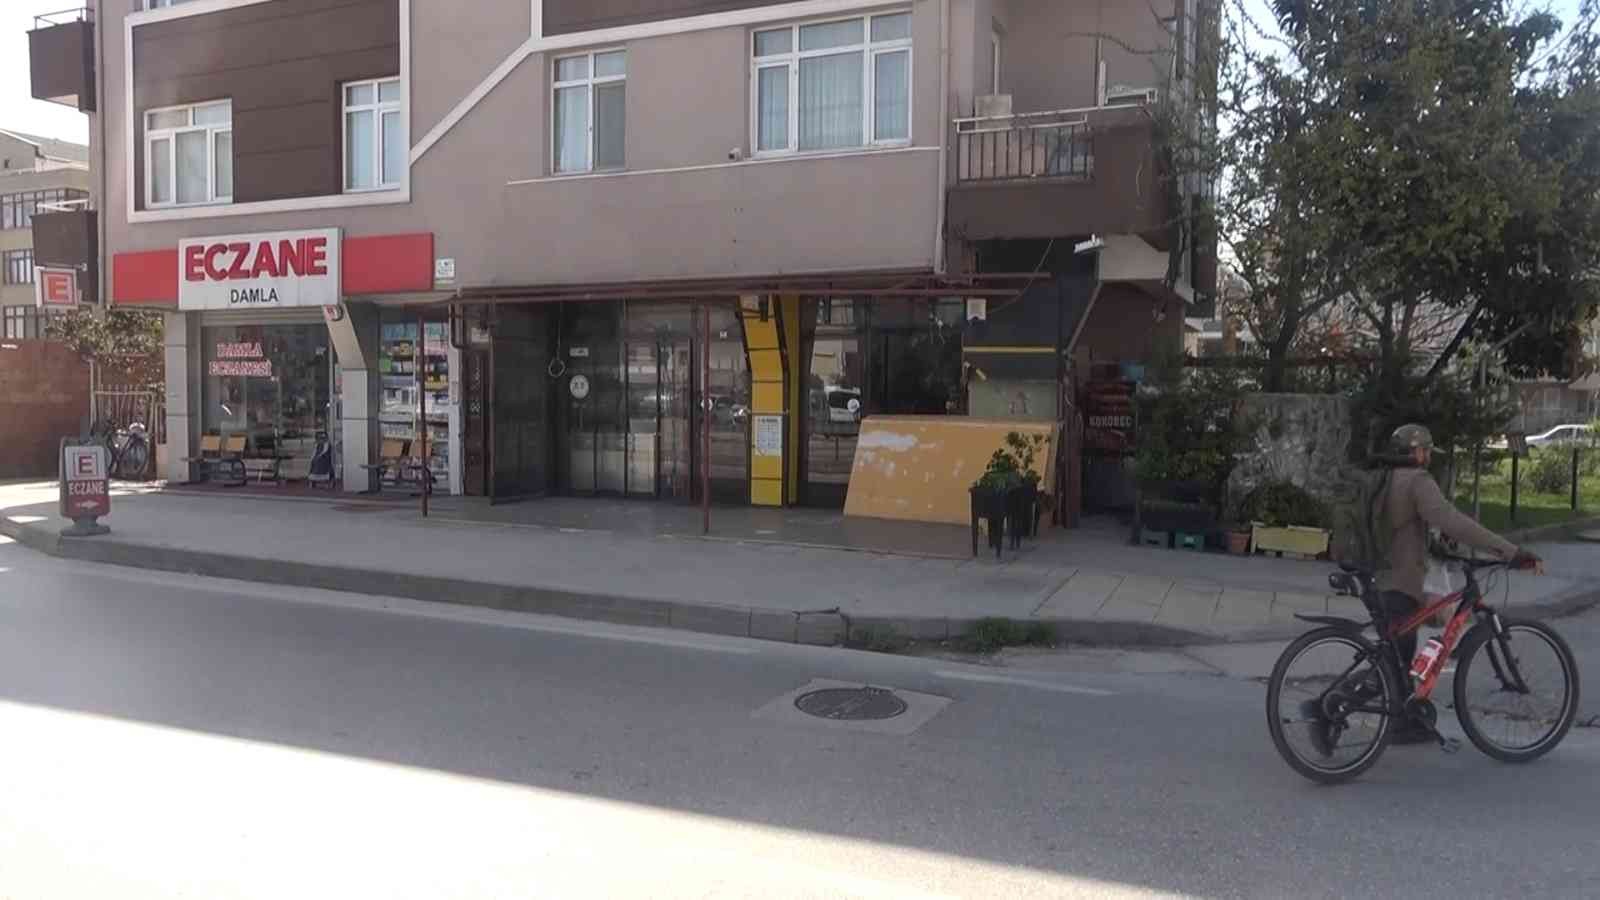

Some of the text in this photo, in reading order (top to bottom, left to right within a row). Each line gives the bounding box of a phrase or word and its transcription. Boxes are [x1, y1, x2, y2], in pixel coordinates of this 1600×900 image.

[185, 237, 327, 281] ECZANE
[230, 288, 278, 303] DAMLA
[216, 342, 264, 357] DAMLA
[79, 455, 94, 474] E
[68, 481, 105, 496] ECZANE
